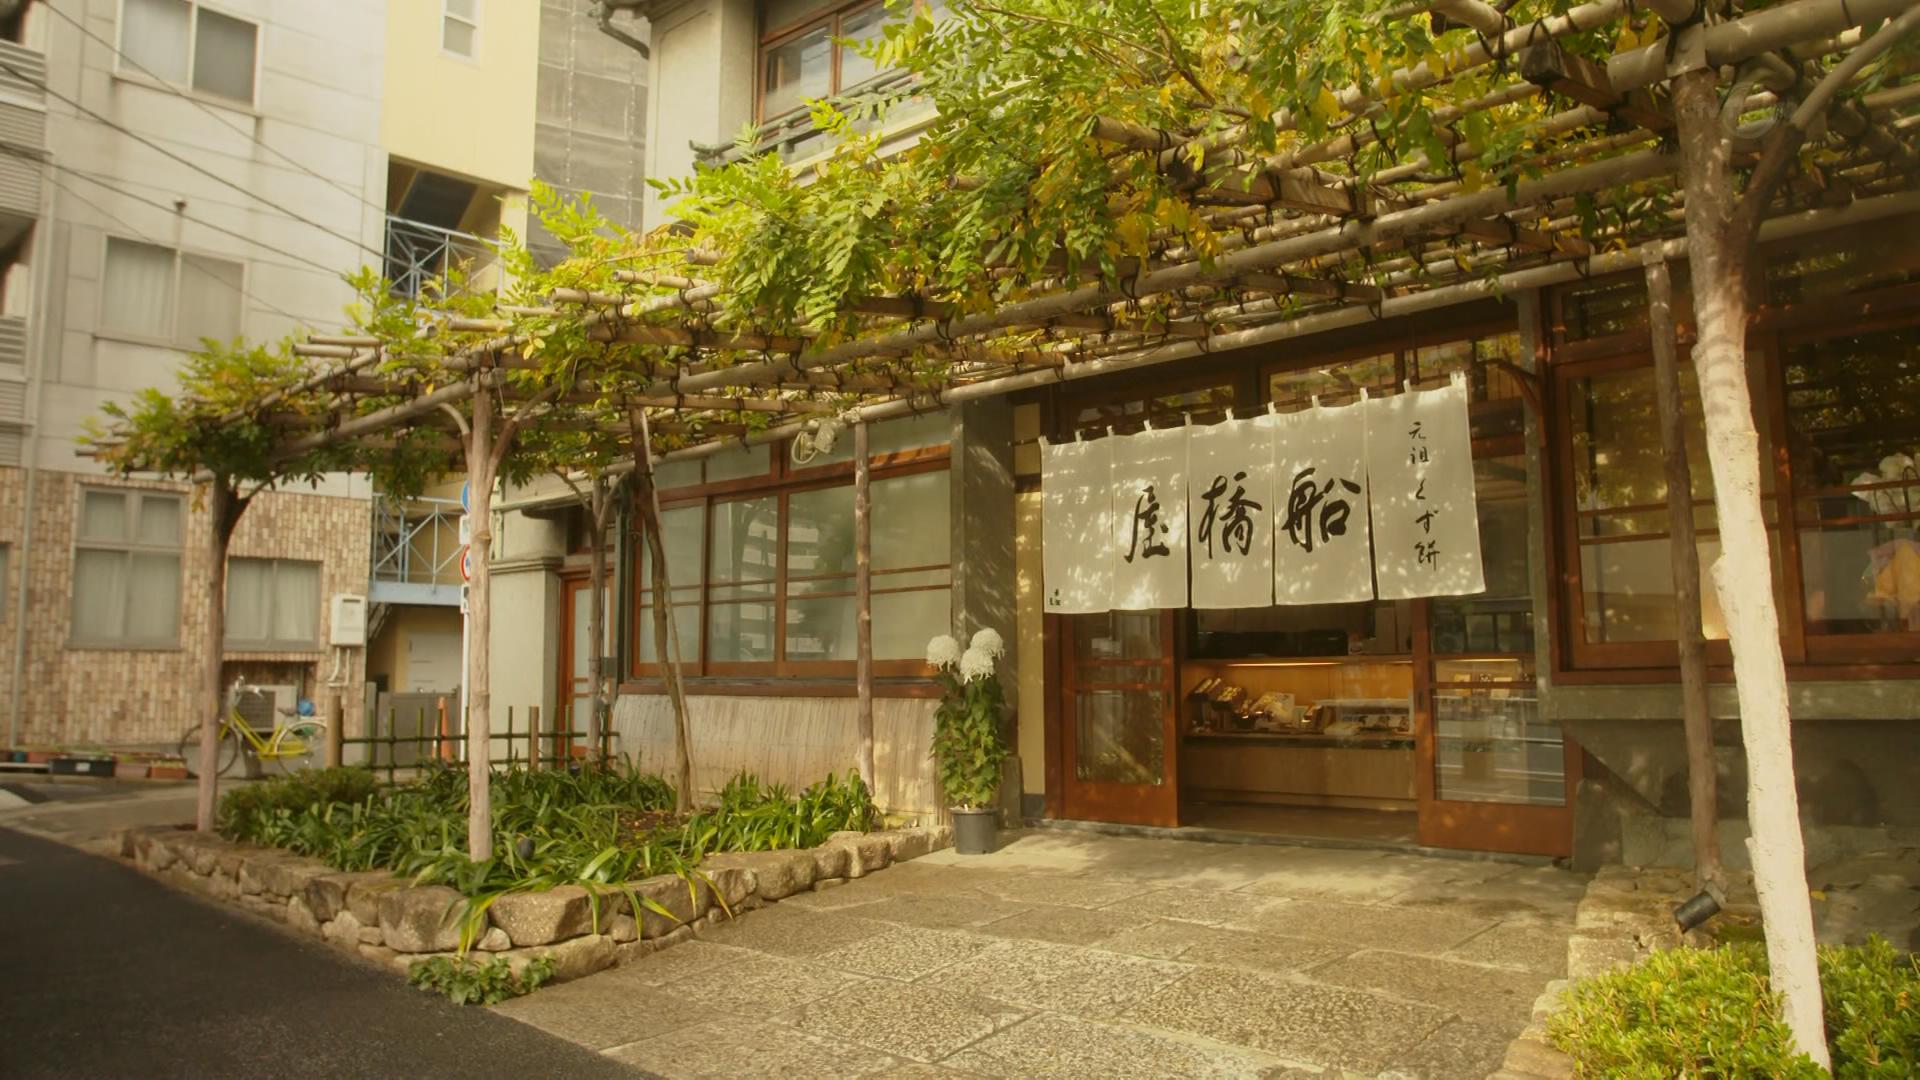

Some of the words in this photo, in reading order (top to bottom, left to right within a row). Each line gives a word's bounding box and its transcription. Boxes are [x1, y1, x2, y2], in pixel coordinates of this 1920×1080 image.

[1408, 421, 1440, 571] 元祖くず餅
